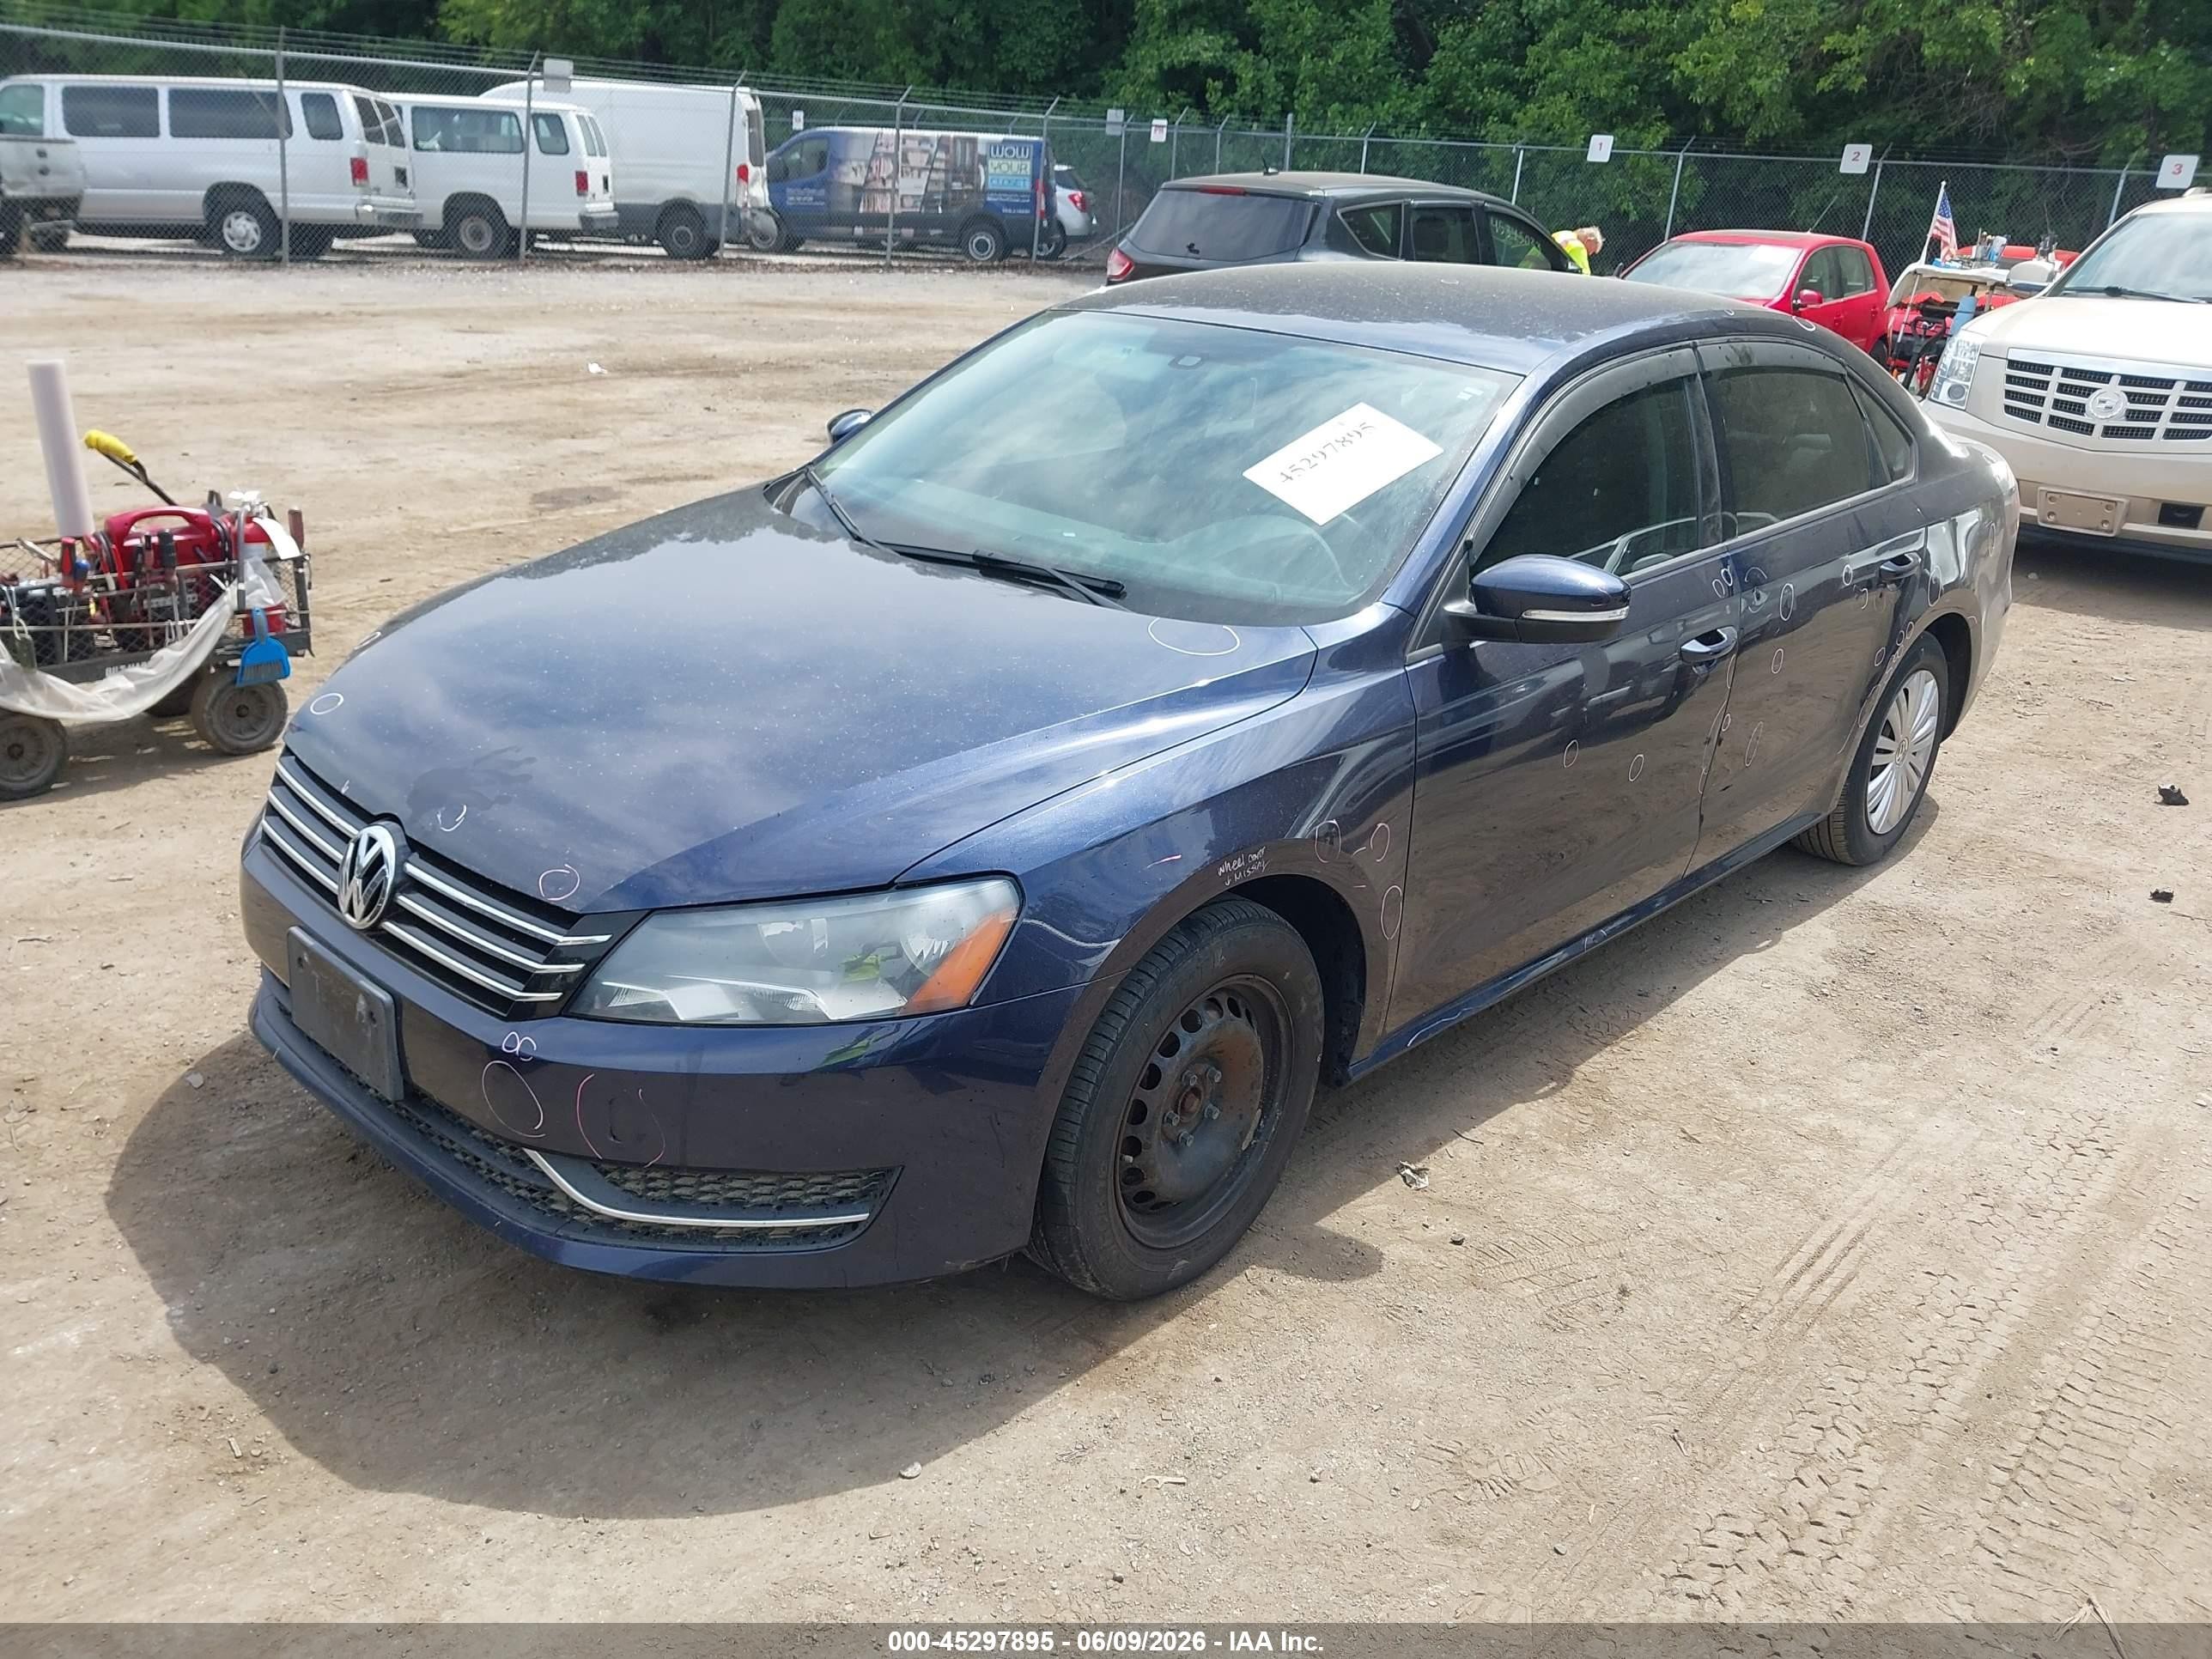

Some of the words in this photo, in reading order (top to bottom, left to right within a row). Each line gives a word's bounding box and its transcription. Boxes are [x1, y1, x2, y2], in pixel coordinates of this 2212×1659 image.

[990, 144, 1030, 158] WOW
[1851, 151, 1861, 161] 2
[990, 161, 1029, 173] YOUR
[2172, 163, 2184, 175] 3
[1279, 422, 1376, 483] 45297895
[1217, 853, 1245, 877] wheel
